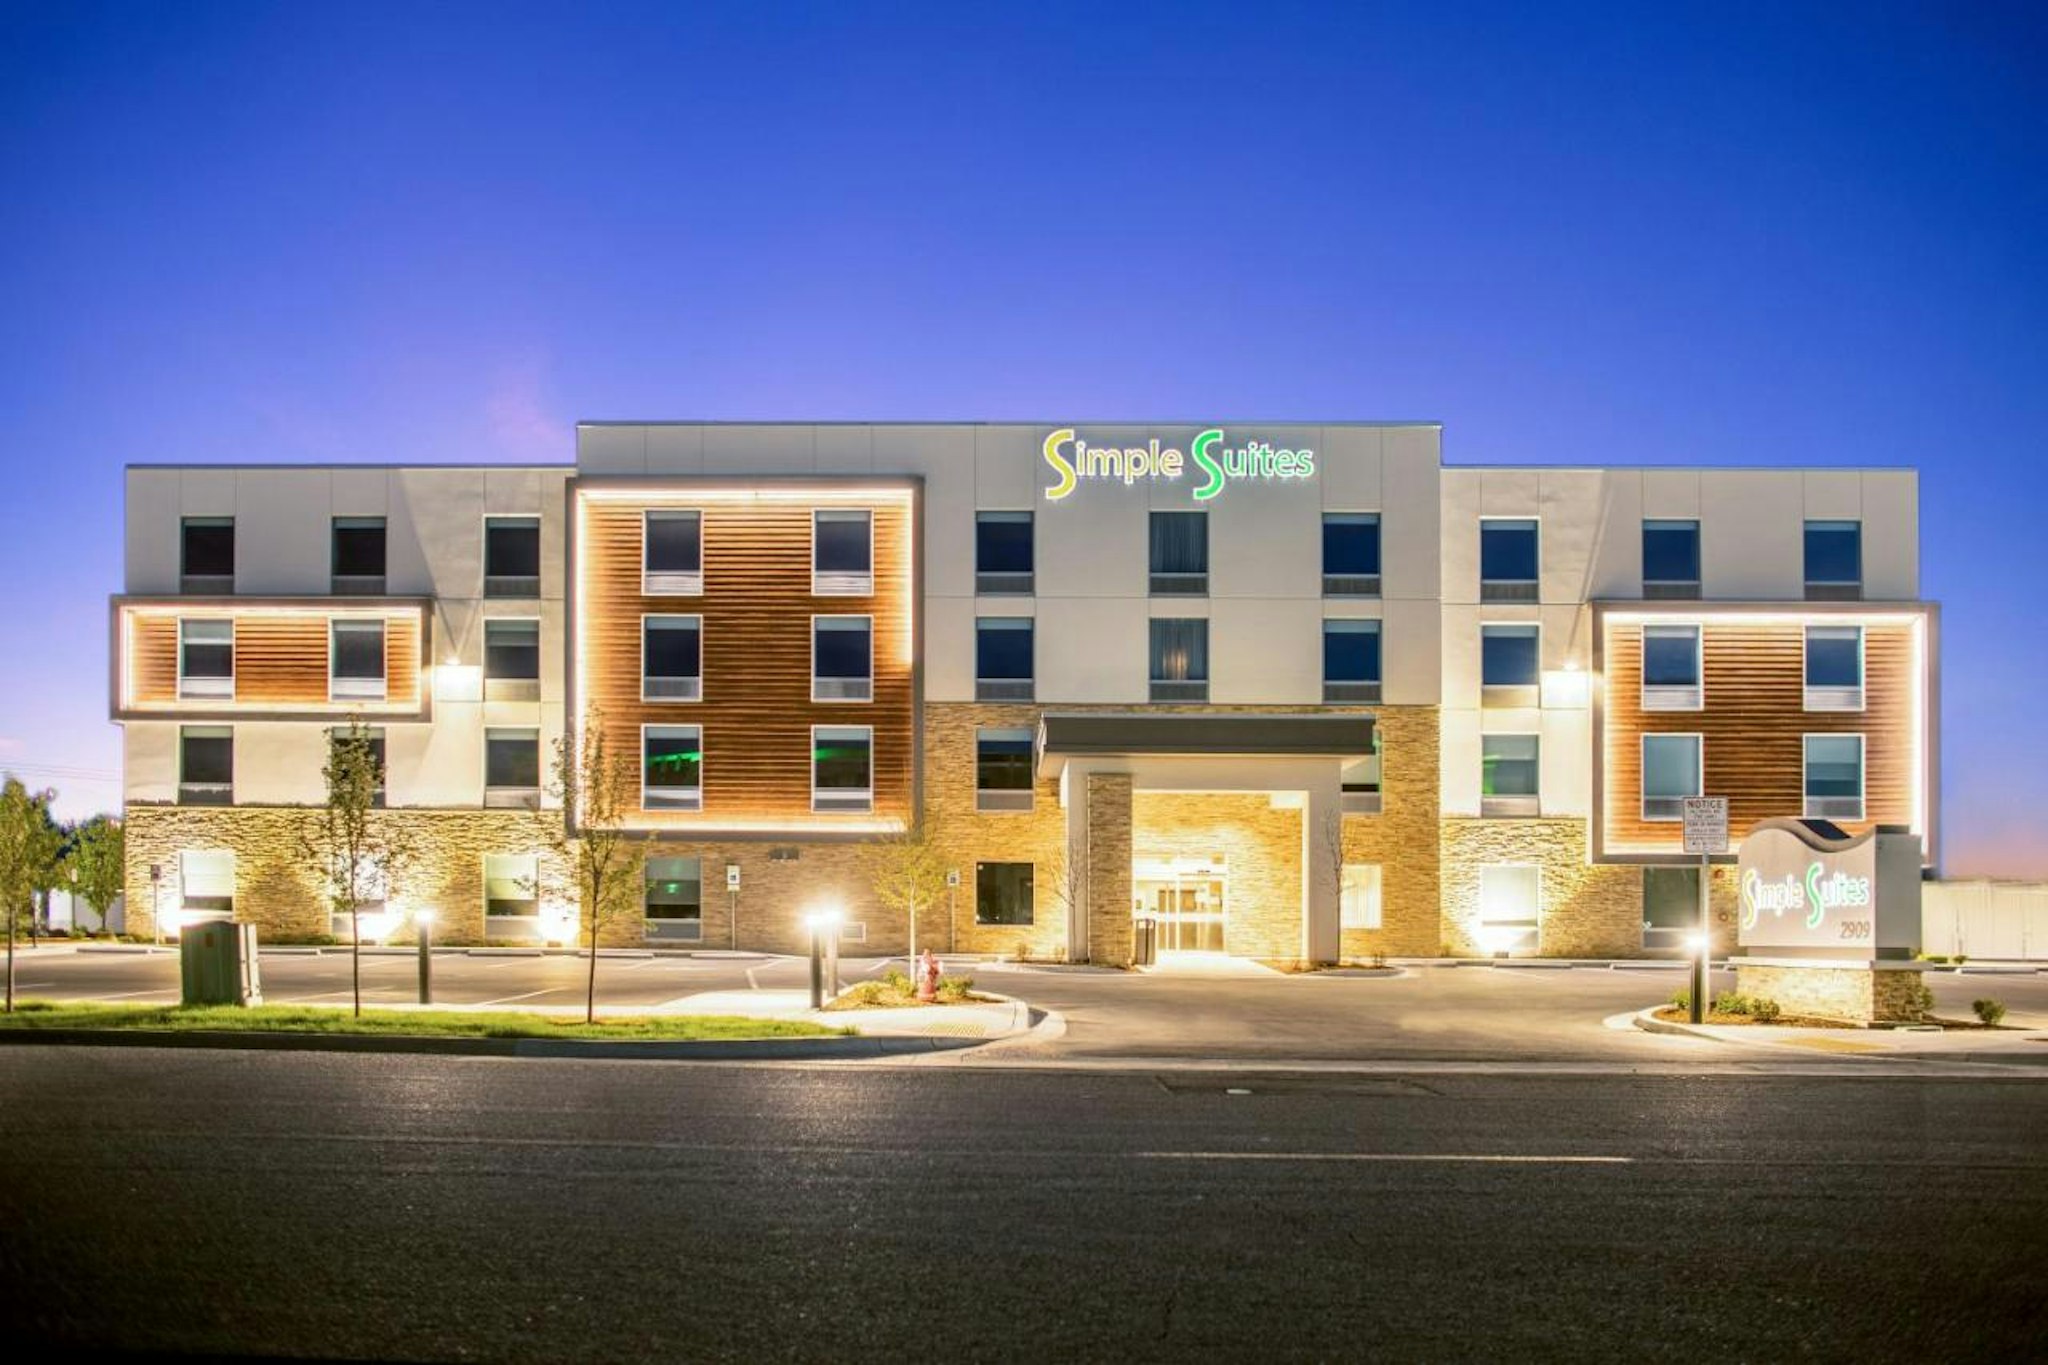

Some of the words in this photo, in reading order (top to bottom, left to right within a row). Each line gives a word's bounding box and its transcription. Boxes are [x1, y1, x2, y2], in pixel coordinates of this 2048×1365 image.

[1043, 429, 1184, 500] Simple
[1192, 429, 1314, 500] Suites
[1687, 800, 1724, 809] NOTICE
[1742, 868, 1804, 930] Simple
[1806, 862, 1869, 929] Suites
[1840, 921, 1871, 939] 2909
